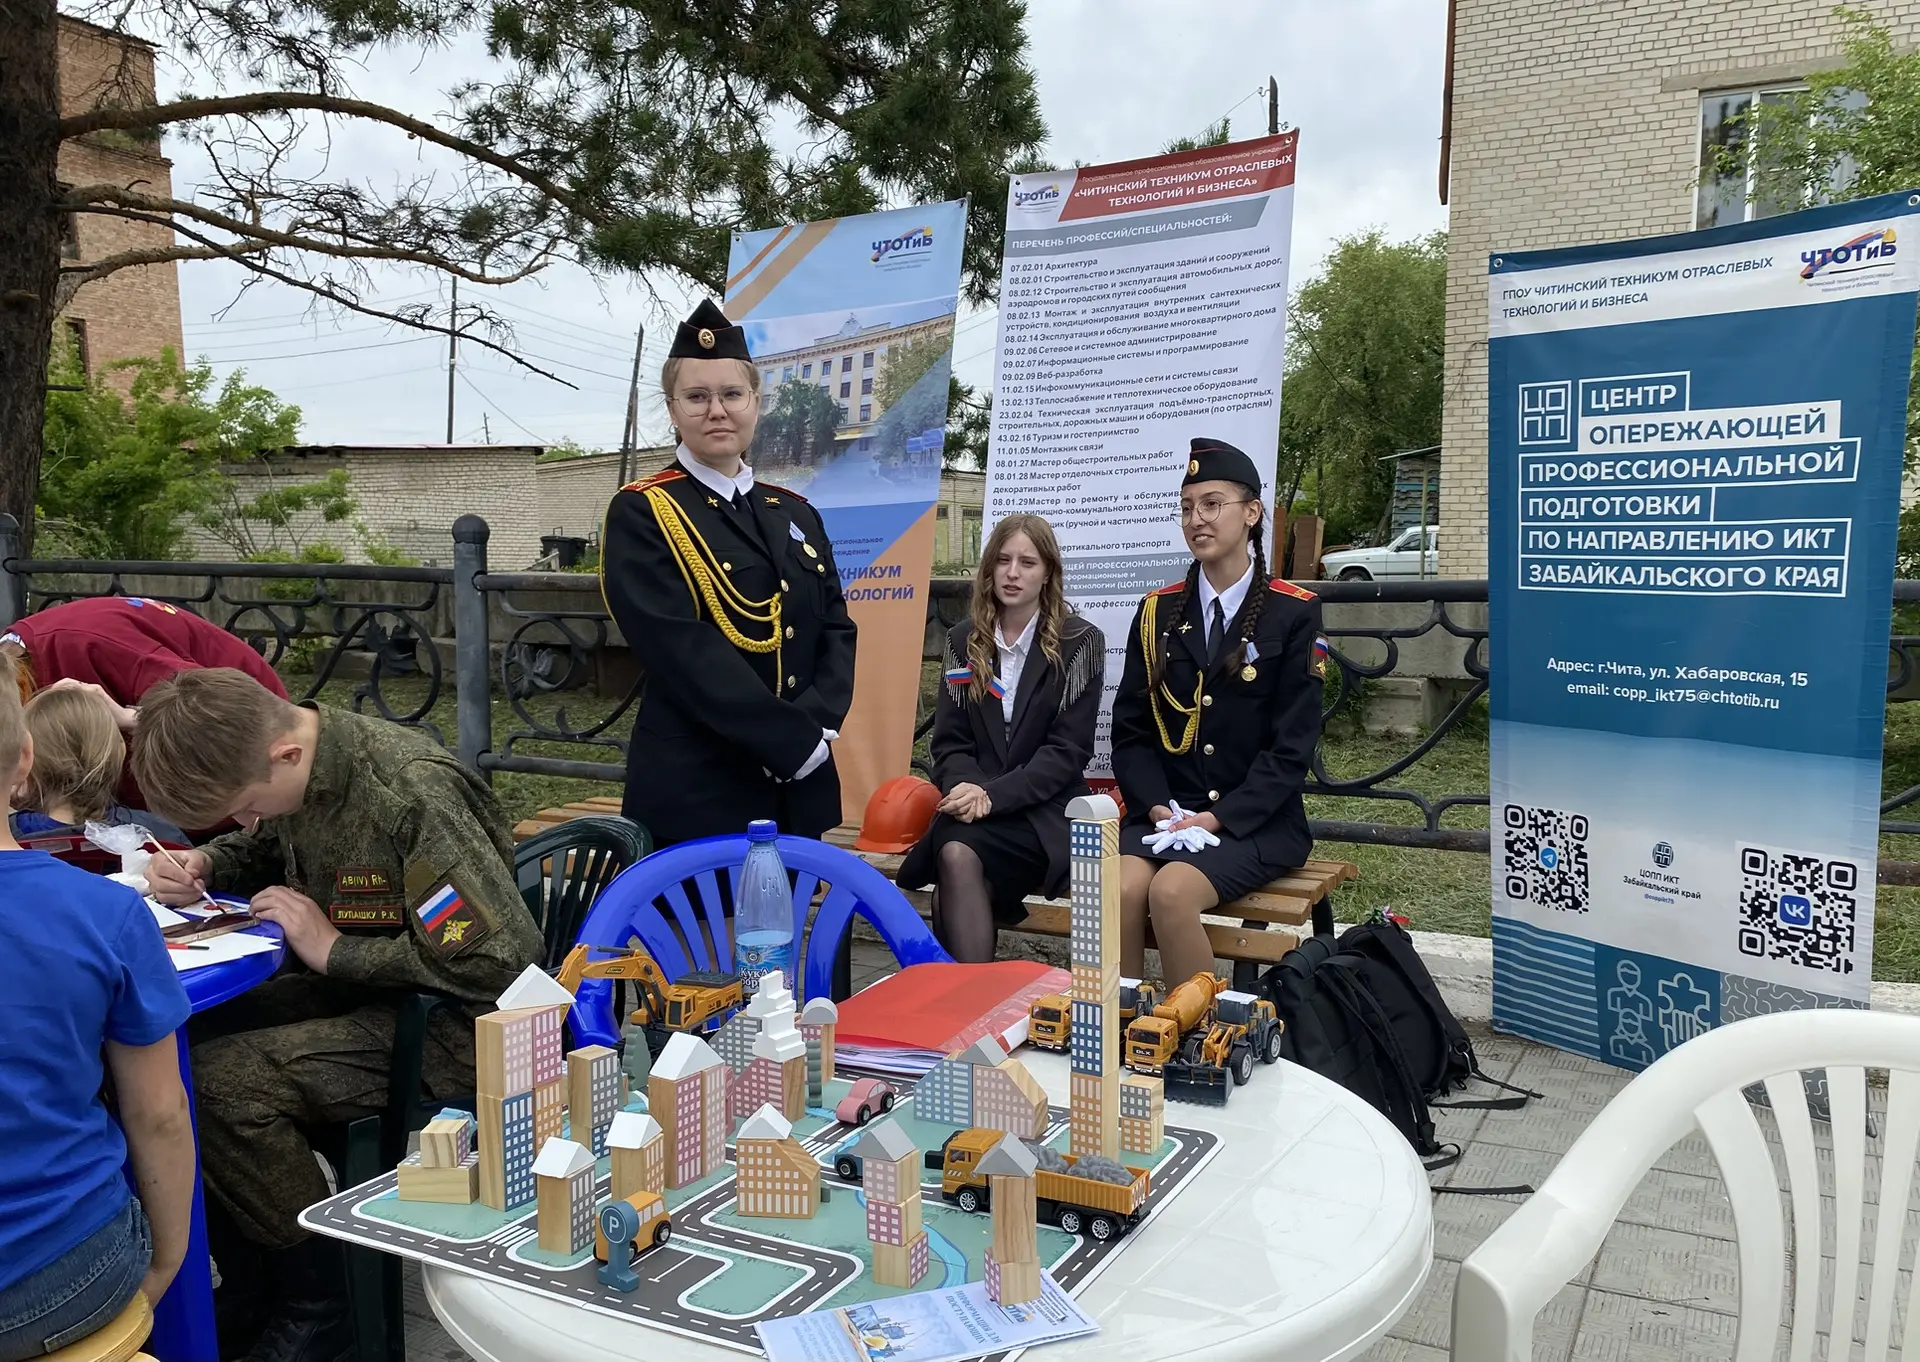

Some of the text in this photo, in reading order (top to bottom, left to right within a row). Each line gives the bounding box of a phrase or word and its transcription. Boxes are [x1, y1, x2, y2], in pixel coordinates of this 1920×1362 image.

[1075, 154, 1292, 198] «ЧИТИНСКИЙ ТЕХНИКУМ ОТРАСЛЕВЫХ
[1109, 177, 1257, 207] ТЕХНОЛОГИЙ И БИЗНЕСА»
[1012, 214, 1232, 249] ПЕРЕЧЕНЬ ПРОФЕССИЙ/СПЕЦИАЛЬНОСТЕЙ:
[1009, 288, 1042, 297] 08.02.12
[1044, 283, 1108, 296] Строительство
[1119, 274, 1178, 288] эксплуатация
[1180, 264, 1252, 280] автомобильных
[1254, 257, 1283, 269] дорог,
[1010, 276, 1042, 285] 08.02.01
[1044, 270, 1108, 284] Строительство
[1116, 262, 1174, 275] эксплуатация
[1176, 256, 1207, 267] зданий
[1216, 246, 1270, 261] сооружений
[1011, 259, 1098, 272] 07.02.01 Архитектура
[1502, 257, 1773, 300] ГПОУ ЧИТИНСКИЙ ТЕХНИКУМ ОТРАСЛЕВЫХ
[1007, 311, 1040, 320] 08.02.13
[1045, 310, 1077, 318] Монтаж
[1091, 302, 1149, 314] эксплуатация
[1154, 294, 1205, 306] внутренних
[1210, 282, 1281, 299] сантехнических
[1008, 298, 1060, 308] аэродромов
[1068, 293, 1110, 304] городских
[1112, 288, 1136, 299] путей
[1138, 283, 1186, 295] сообщения
[1502, 292, 1648, 319] ТЕХНОЛОГИЙ И БИЗНЕСА
[1005, 335, 1038, 343] 08.02.14
[1040, 329, 1098, 341] Эксплуатация
[1106, 322, 1169, 336] обслуживание
[1171, 311, 1252, 328] многоквартирного
[1253, 307, 1276, 318] дома
[1053, 312, 1139, 328] кондиционирования
[1144, 308, 1178, 318] воздуха
[1187, 300, 1240, 313] вентиляции
[1003, 360, 1036, 368] 09.02.07
[1038, 355, 1115, 368] Информационные
[1117, 350, 1154, 360] системы
[1162, 338, 1249, 356] программирование
[1004, 347, 1037, 356] 09.02.06
[1039, 346, 1073, 354] Сетевое
[1081, 341, 1126, 350] системное
[1127, 329, 1217, 346] администрирование
[1001, 385, 1034, 394] 11.02.15
[1035, 377, 1143, 392] Инфокоммуникационные
[1144, 375, 1164, 383] сети
[1172, 370, 1210, 380] системы
[1212, 367, 1238, 375] связи
[1002, 368, 1103, 381] 09.02.09 Веб-разработка
[999, 388, 1274, 419] 23.02.04 Техническая эксплуатация подъёмно-транспортных,
[1001, 398, 1034, 406] 13.02.13
[1035, 394, 1105, 405] Теплоснабжение
[1113, 385, 1192, 399] теплотехническое
[1193, 377, 1258, 391] оборудование
[1591, 384, 1677, 412] ЦЕНТР
[1063, 418, 1107, 428] дорожных
[1109, 415, 1137, 423] машин
[1146, 407, 1209, 420] оборудования
[1211, 406, 1225, 415] (по
[1227, 399, 1272, 412] отраслям)
[1590, 408, 1826, 444] ОПЕРЕЖАЮЩЕЙ
[998, 434, 1031, 442] 43.02.16
[1033, 434, 1062, 443] Туризм
[1071, 427, 1139, 439] гостеприимство
[996, 450, 1173, 468] 08.01.27 Мастер общестроительных работ
[997, 444, 1103, 455] 11.01.05 Монтажник связи
[995, 473, 1028, 481] 08.01.28
[1030, 472, 1060, 480] Мастер
[1062, 469, 1113, 479] отделочных
[1115, 465, 1177, 476] строительных
[1529, 446, 1844, 482] ПРОФЕССИОНАЛЬНОЙ
[993, 483, 1081, 494] декоративных работ
[1081, 495, 1118, 504] ремонту
[1134, 502, 1178, 511] хозяйства
[1529, 495, 1700, 520] ПОДГОТОВКИ
[1066, 518, 1099, 529] (ручной
[1108, 517, 1147, 525] частично
[1121, 540, 1171, 550] транспорта
[1529, 528, 1836, 550] ПО НАПРАВЛЕНИЮ ИКТ
[838, 565, 902, 580] ХНИКУМ
[1086, 557, 1180, 570] ПРОФЕССИОНАЛЬНОЙ
[1529, 562, 1839, 588] ЗАБАЙКАЛЬСКОГО КРАЯ
[842, 584, 914, 601] НОЛОГИЙ
[1118, 581, 1144, 589] (ЦОПП
[1147, 579, 1165, 587] ИКТ)
[1547, 658, 1808, 687] Адрес: г.Чита, ул. Хабаровская, 15
[1567, 682, 1779, 710] email: copp_ikt75@chtotib.ru
[1623, 876, 1701, 899] Забайкальский край
[1640, 869, 1680, 884] ЦОПП ИКТ
[338, 911, 397, 920] ЛУПАШКУ Р.К.
[609, 1216, 619, 1233] P
